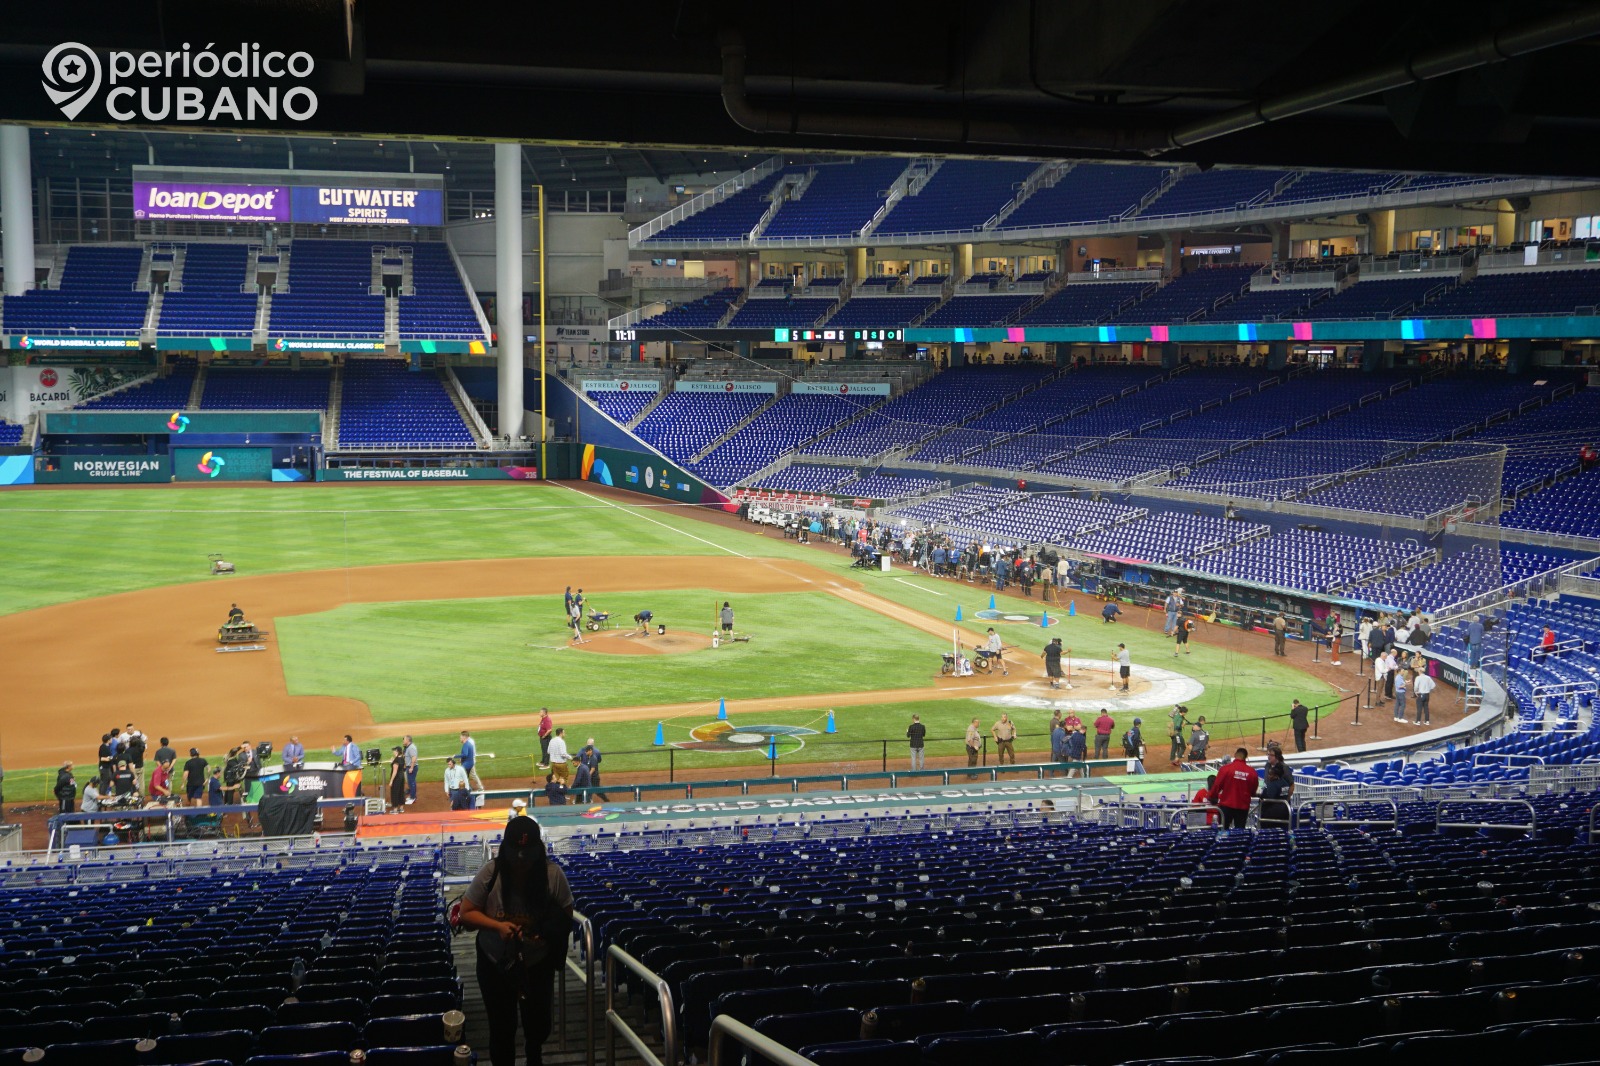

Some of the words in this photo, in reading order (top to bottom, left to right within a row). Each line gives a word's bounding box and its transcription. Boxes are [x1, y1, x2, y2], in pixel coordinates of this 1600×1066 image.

[148, 187, 275, 214] loanDepot
[319, 188, 415, 207] CUTWATER
[348, 208, 388, 218] SPIRITS
[615, 330, 636, 341] 11:11
[792, 330, 798, 340] 5
[854, 331, 861, 339] B
[870, 331, 877, 339] S
[346, 342, 374, 350] CLASSIC
[30, 390, 70, 402] BACARDÍ
[74, 461, 159, 471] NORWEGIAN
[344, 470, 363, 478] THE
[363, 470, 406, 478] FESTIVAL
[407, 470, 420, 478] OF
[421, 469, 468, 478] BASEBALL
[635, 800, 760, 815] WORLD
[767, 792, 936, 808] BASEBALL
[941, 784, 1073, 798] CLASSIC
